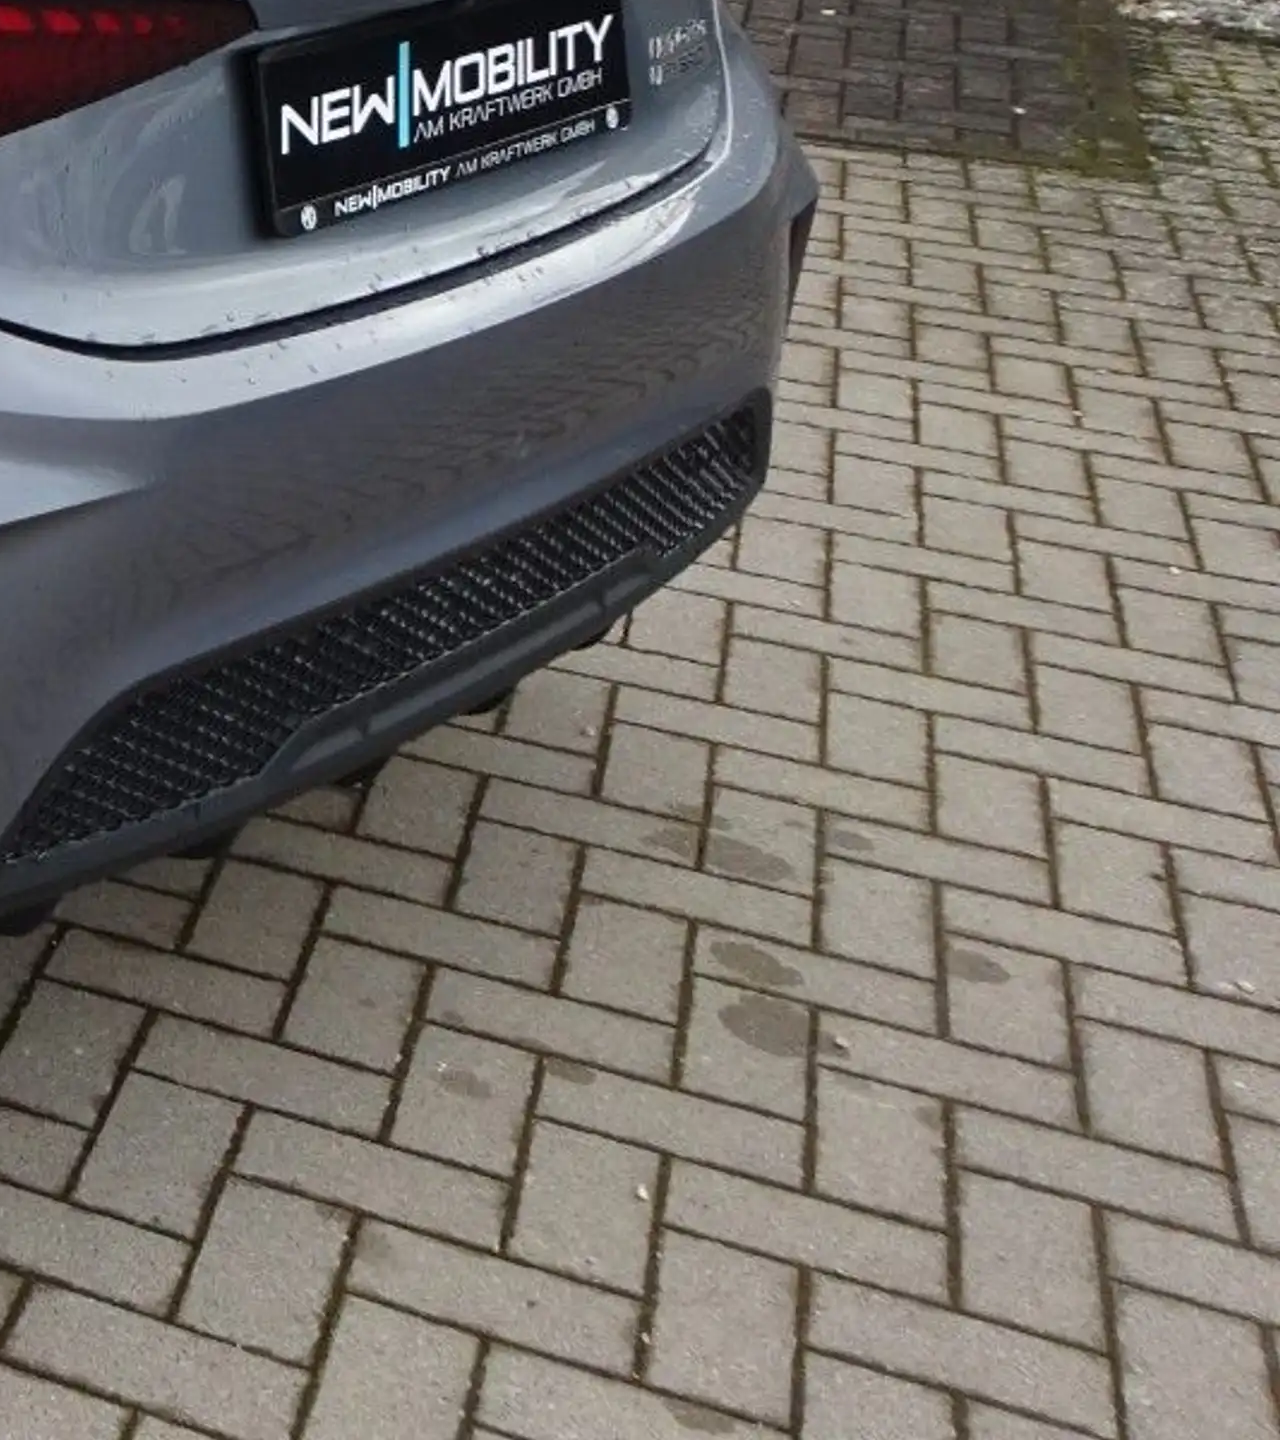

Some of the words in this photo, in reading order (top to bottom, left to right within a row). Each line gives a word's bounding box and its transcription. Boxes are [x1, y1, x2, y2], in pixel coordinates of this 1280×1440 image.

[280, 75, 397, 155] NEW
[412, 14, 614, 116] MOBILITY
[413, 119, 444, 144] AM
[448, 83, 554, 132] KRAFTWERK
[479, 132, 559, 171] KRAFTWERK
